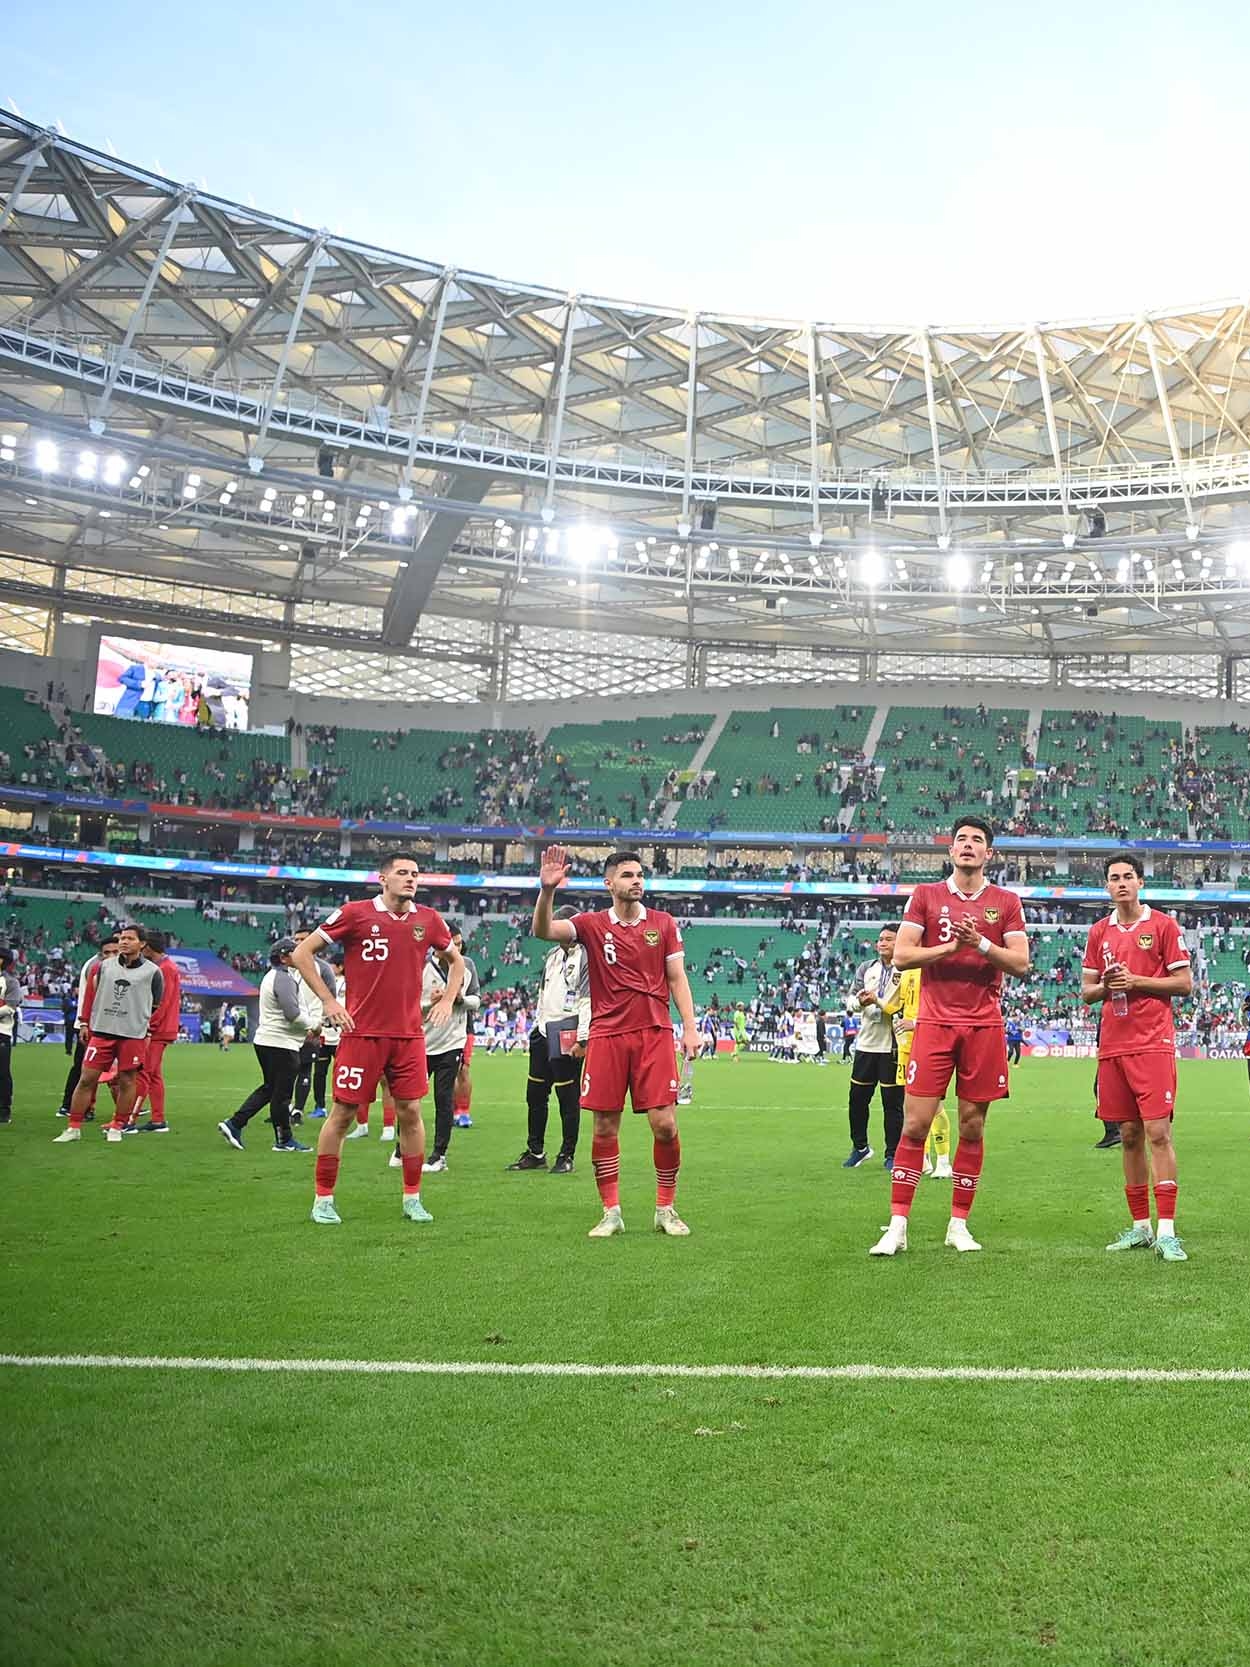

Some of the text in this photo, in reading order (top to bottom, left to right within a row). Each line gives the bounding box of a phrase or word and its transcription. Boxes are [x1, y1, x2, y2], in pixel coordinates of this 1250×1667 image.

[938, 918, 951, 942] 3
[361, 938, 389, 961] 25
[603, 943, 617, 965] 6
[336, 1066, 364, 1090] 25
[907, 1060, 918, 1085] 3
